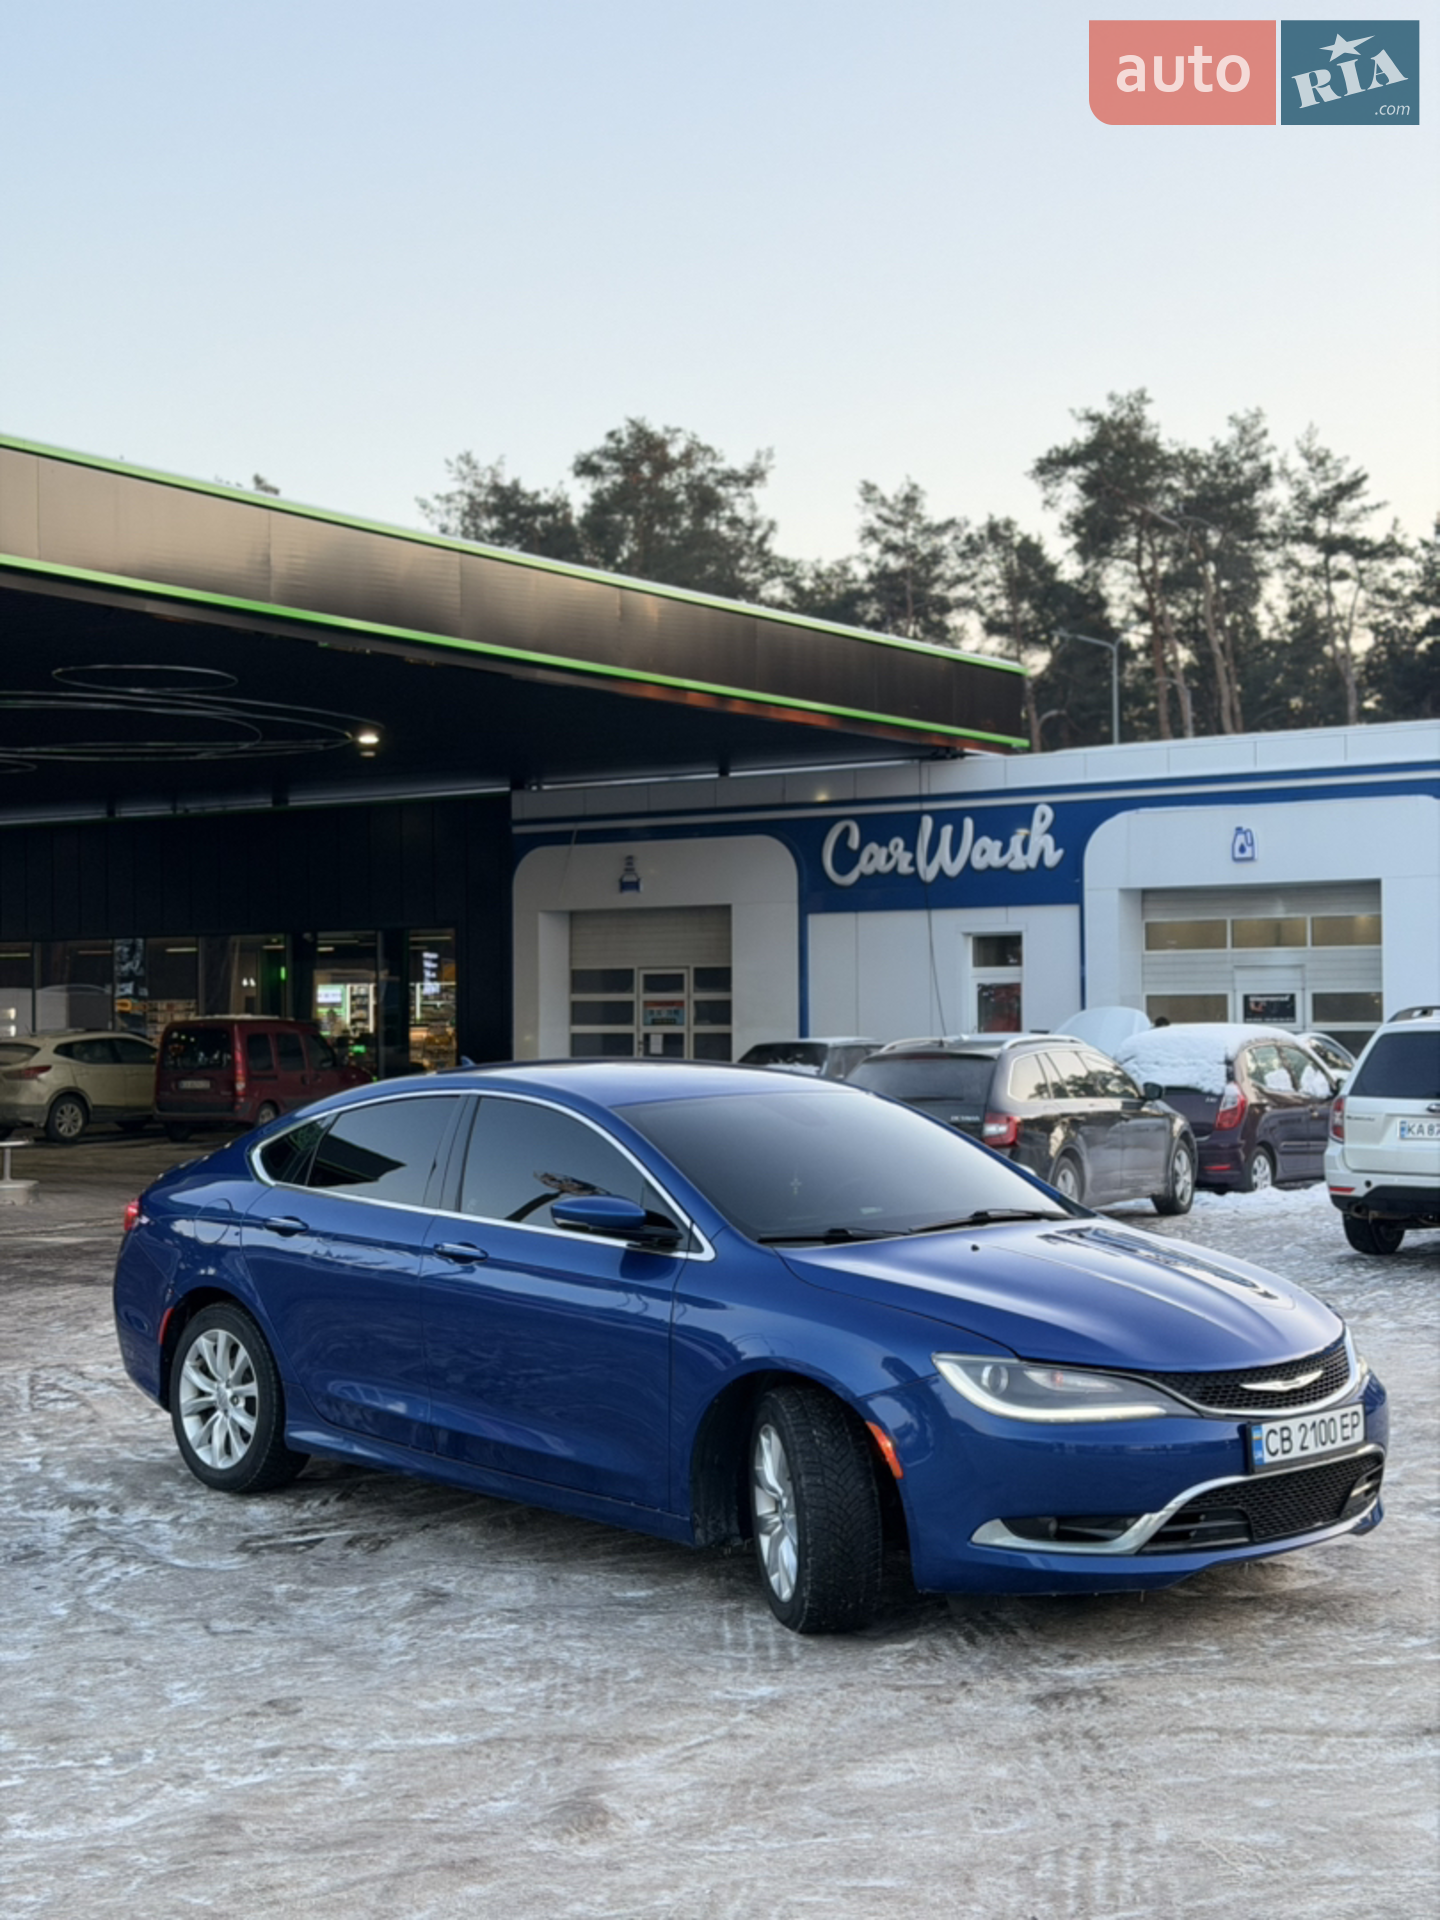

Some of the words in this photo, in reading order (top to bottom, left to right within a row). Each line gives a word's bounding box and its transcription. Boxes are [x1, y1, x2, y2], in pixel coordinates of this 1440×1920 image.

[1265, 1425, 1294, 1457] CB
[1298, 1416, 1338, 1451] 2100
[1340, 1411, 1361, 1442] EP
